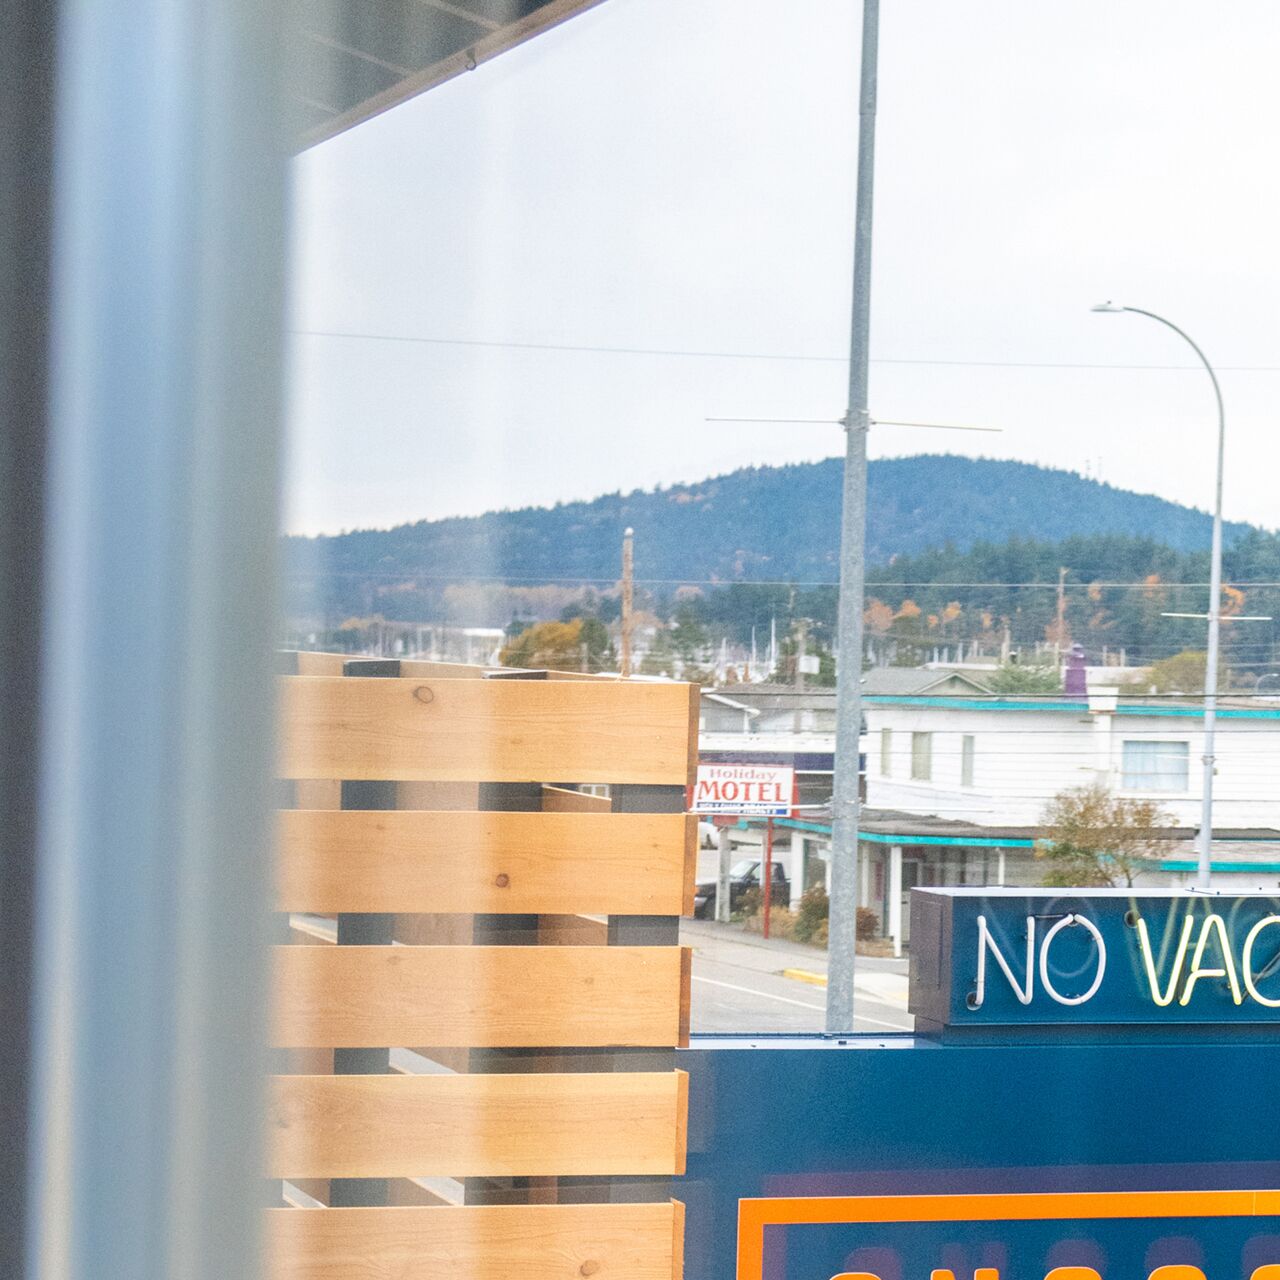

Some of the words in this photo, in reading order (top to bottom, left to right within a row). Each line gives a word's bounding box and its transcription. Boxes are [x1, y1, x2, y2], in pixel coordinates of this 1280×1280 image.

[709, 768, 777, 781] Holiday
[697, 780, 789, 802] MOTEL
[973, 914, 1107, 1006] NO
